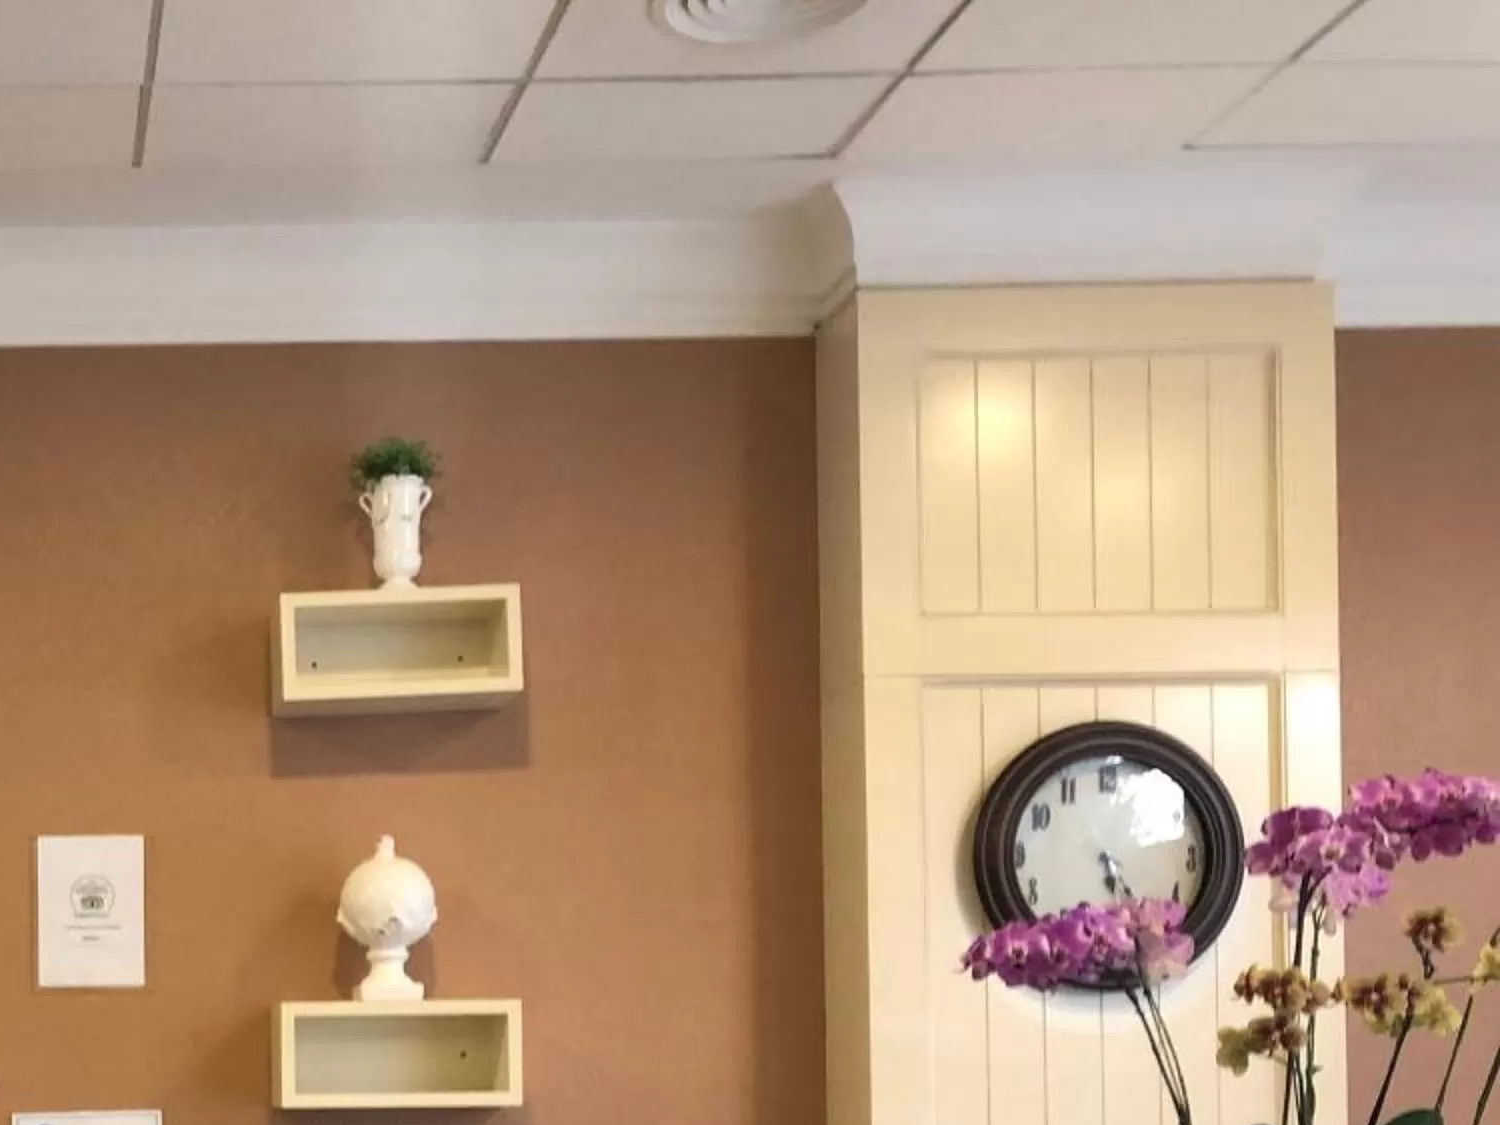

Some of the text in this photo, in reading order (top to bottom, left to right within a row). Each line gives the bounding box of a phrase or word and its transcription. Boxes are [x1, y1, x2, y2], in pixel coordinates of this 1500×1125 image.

[1061, 777, 1077, 804] 11
[1031, 803, 1051, 831] 10
[1186, 845, 1197, 872] 3
